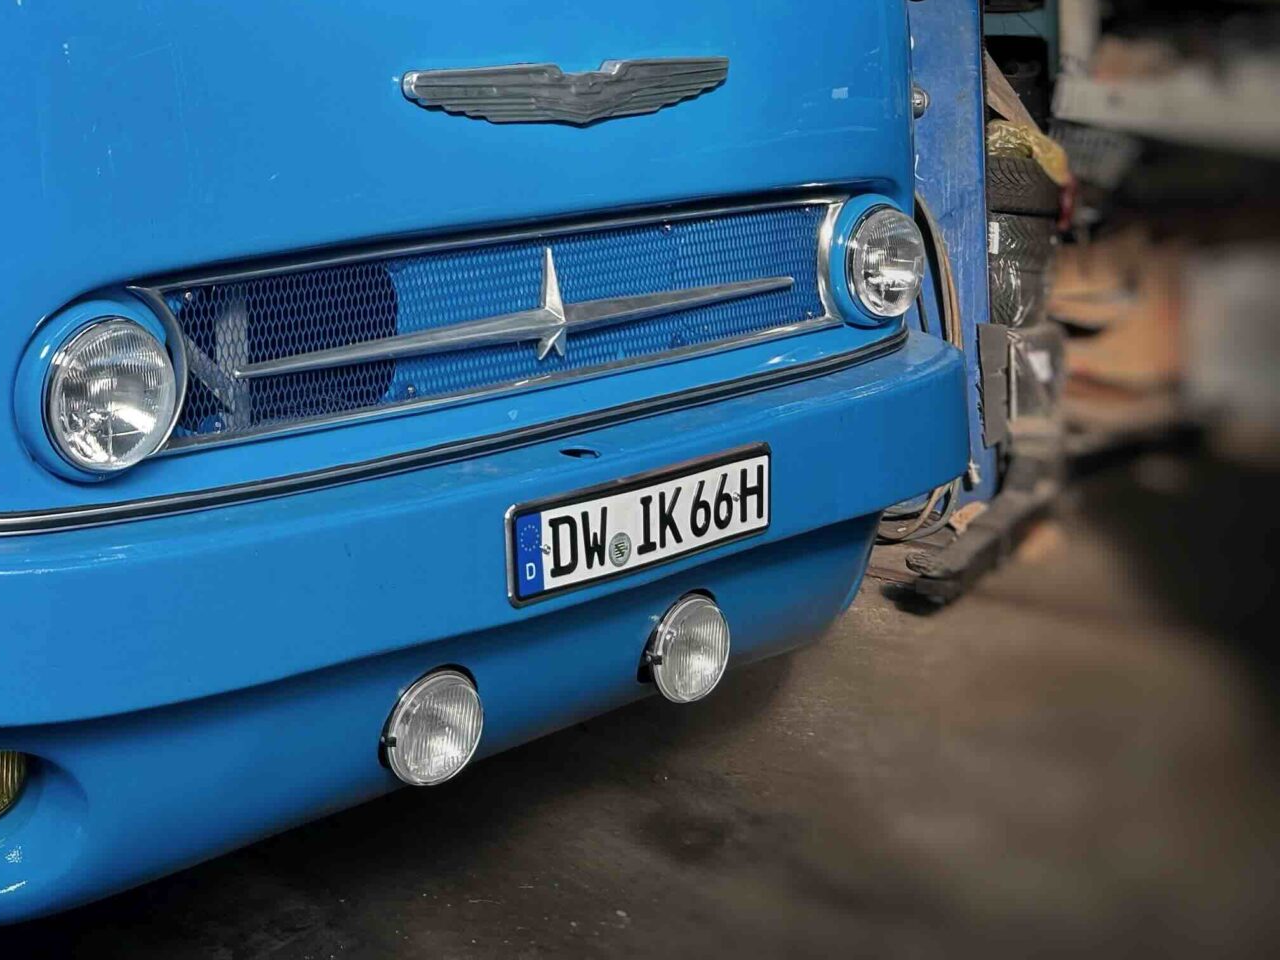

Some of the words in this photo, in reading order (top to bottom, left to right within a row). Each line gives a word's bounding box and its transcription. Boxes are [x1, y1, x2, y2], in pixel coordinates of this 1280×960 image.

[548, 506, 608, 578] DW
[637, 486, 683, 555] IK
[690, 464, 764, 538] 66H
[525, 562, 536, 580] D
